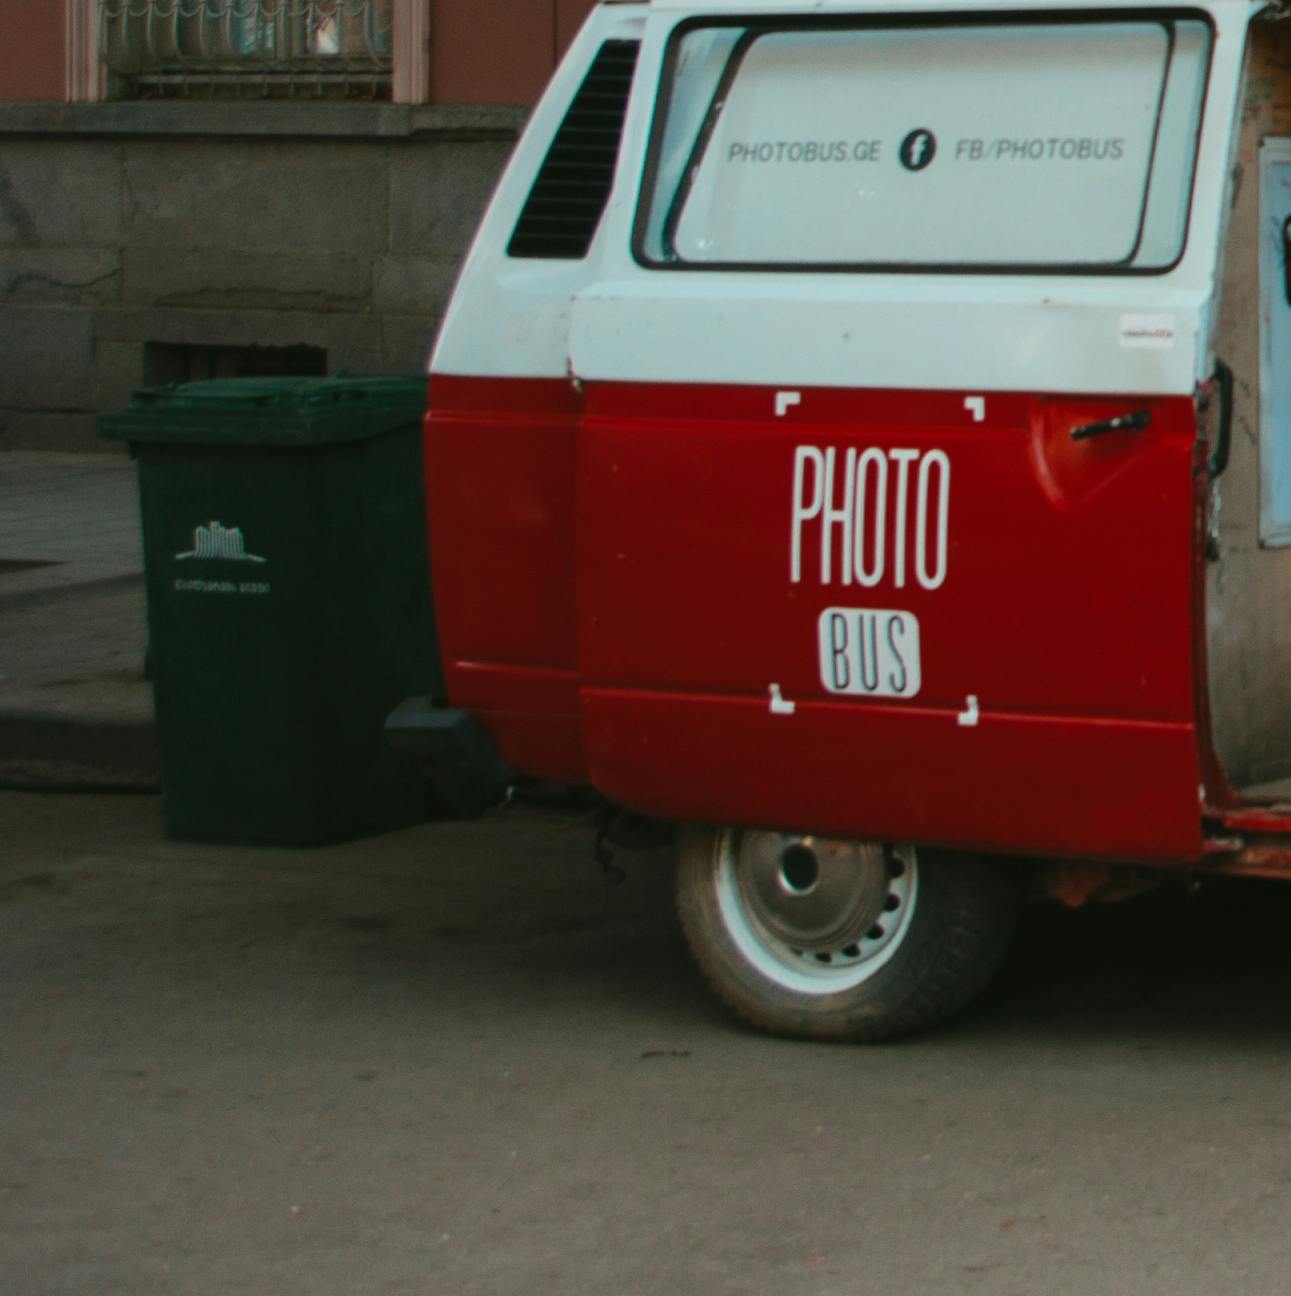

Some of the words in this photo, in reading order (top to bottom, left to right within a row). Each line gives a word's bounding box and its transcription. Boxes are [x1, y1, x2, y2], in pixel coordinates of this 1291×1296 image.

[727, 139, 883, 162] PHOTOBUS.GE
[954, 137, 1126, 161] FB/PHOTOBUS
[790, 445, 950, 590] PHOTO
[830, 612, 908, 694] BUS
